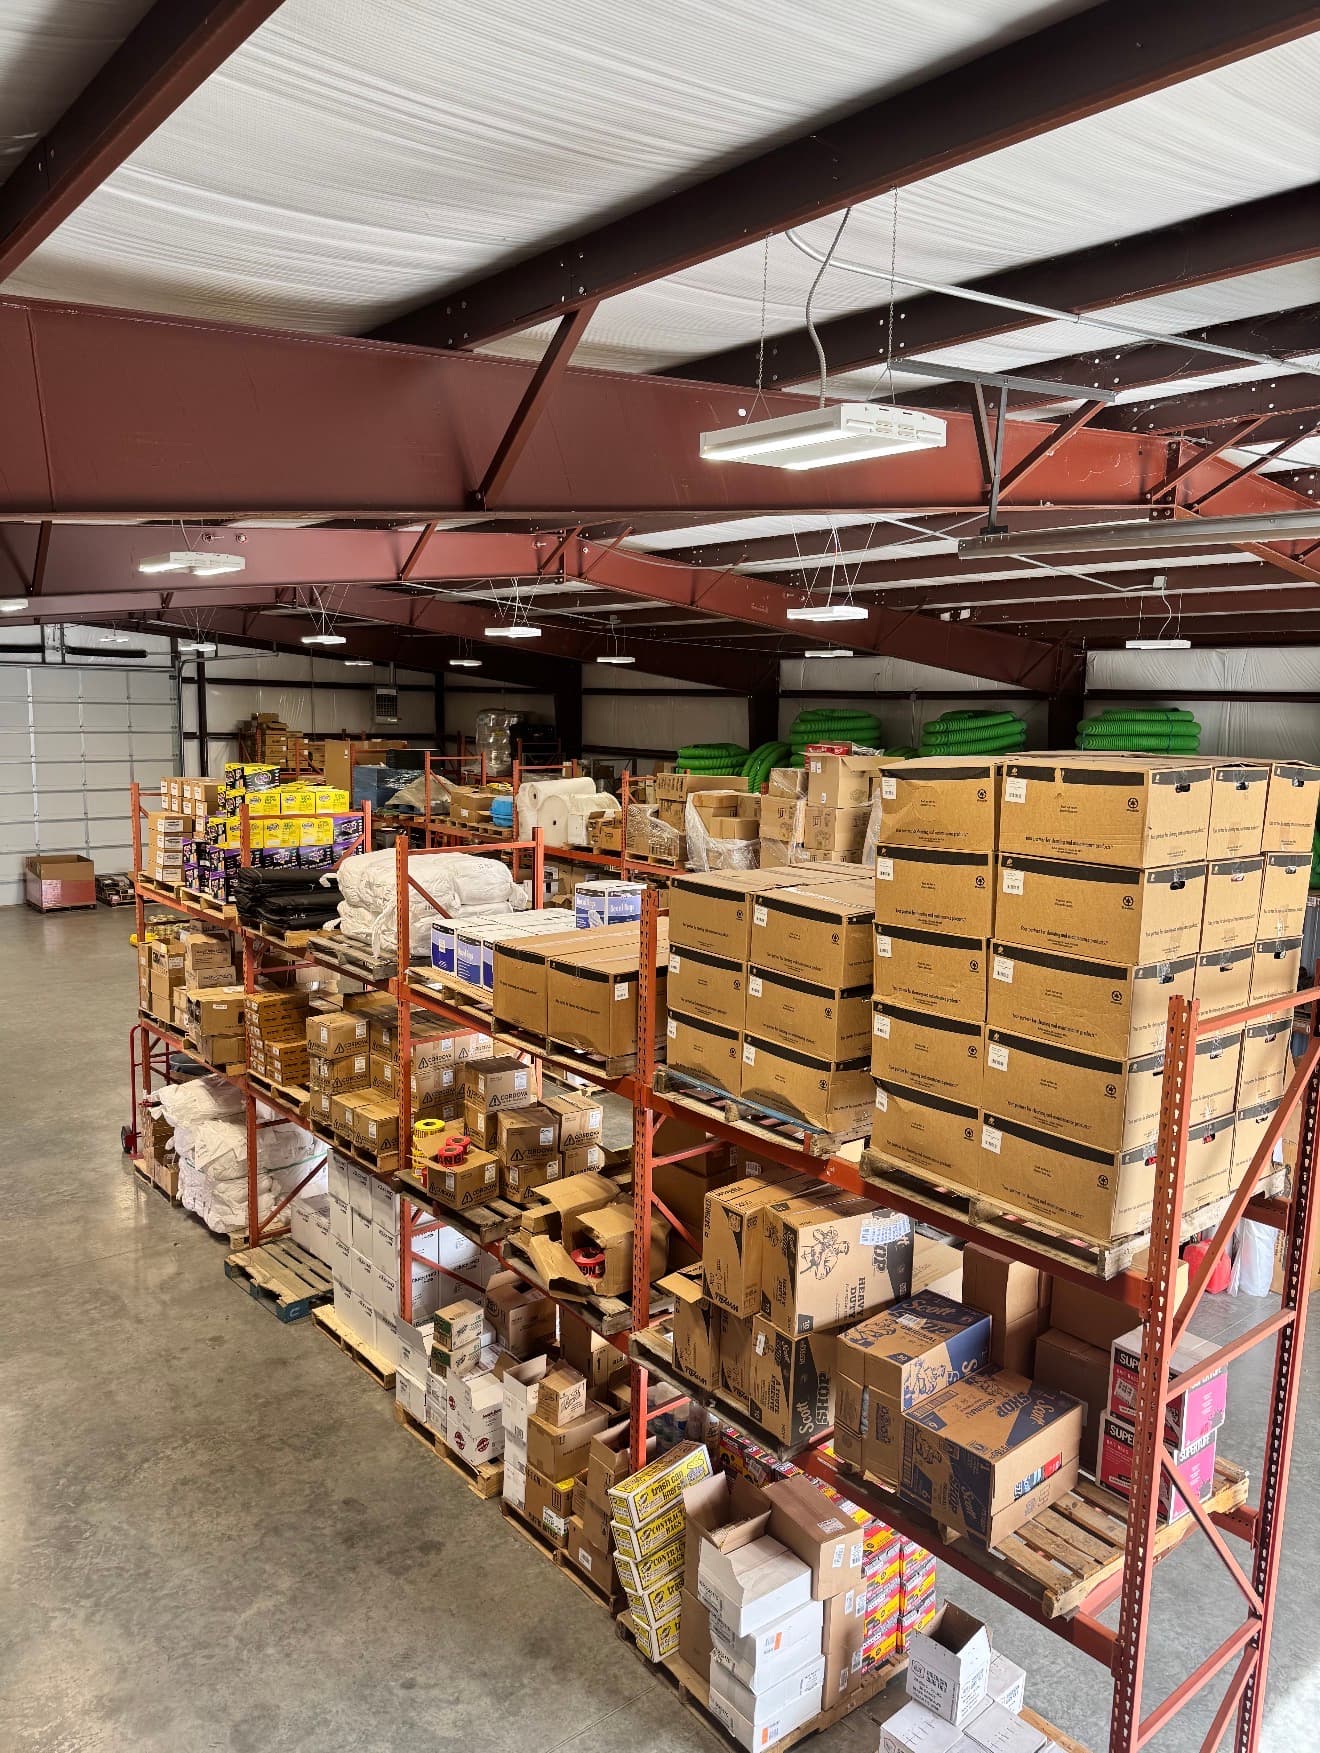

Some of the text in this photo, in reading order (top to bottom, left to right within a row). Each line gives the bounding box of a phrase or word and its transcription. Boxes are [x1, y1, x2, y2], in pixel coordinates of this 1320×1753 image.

[500, 1091, 528, 1101] CORDOVA
[849, 1286, 857, 1319] DUTY
[857, 1276, 866, 1317] HEAVY
[900, 1324, 938, 1343] ORIGINAL
[794, 1401, 815, 1434] Scott
[997, 1393, 1032, 1418] SHOP
[1029, 1399, 1054, 1426] Scott
[651, 1479, 670, 1497] trash
[665, 1520, 682, 1536] BAGS
